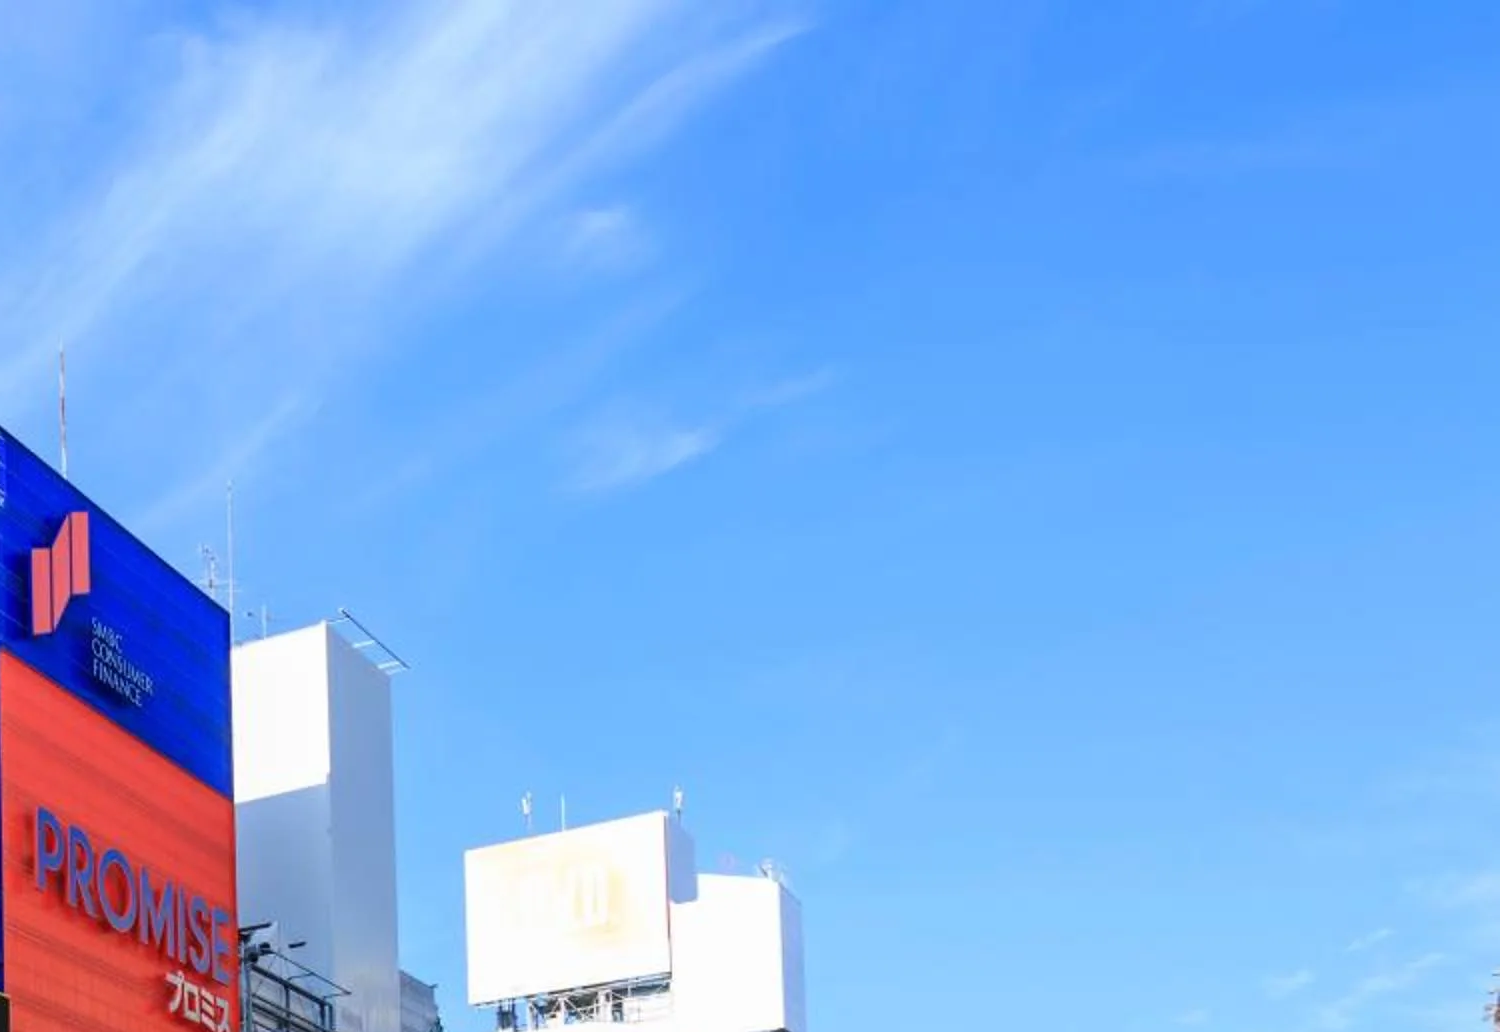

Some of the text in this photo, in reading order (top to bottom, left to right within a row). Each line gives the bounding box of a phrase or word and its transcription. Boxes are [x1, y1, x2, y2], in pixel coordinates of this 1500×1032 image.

[91, 638, 153, 697] CONSUMER
[93, 658, 143, 708] FINANCE
[33, 805, 231, 984] PROMISE
